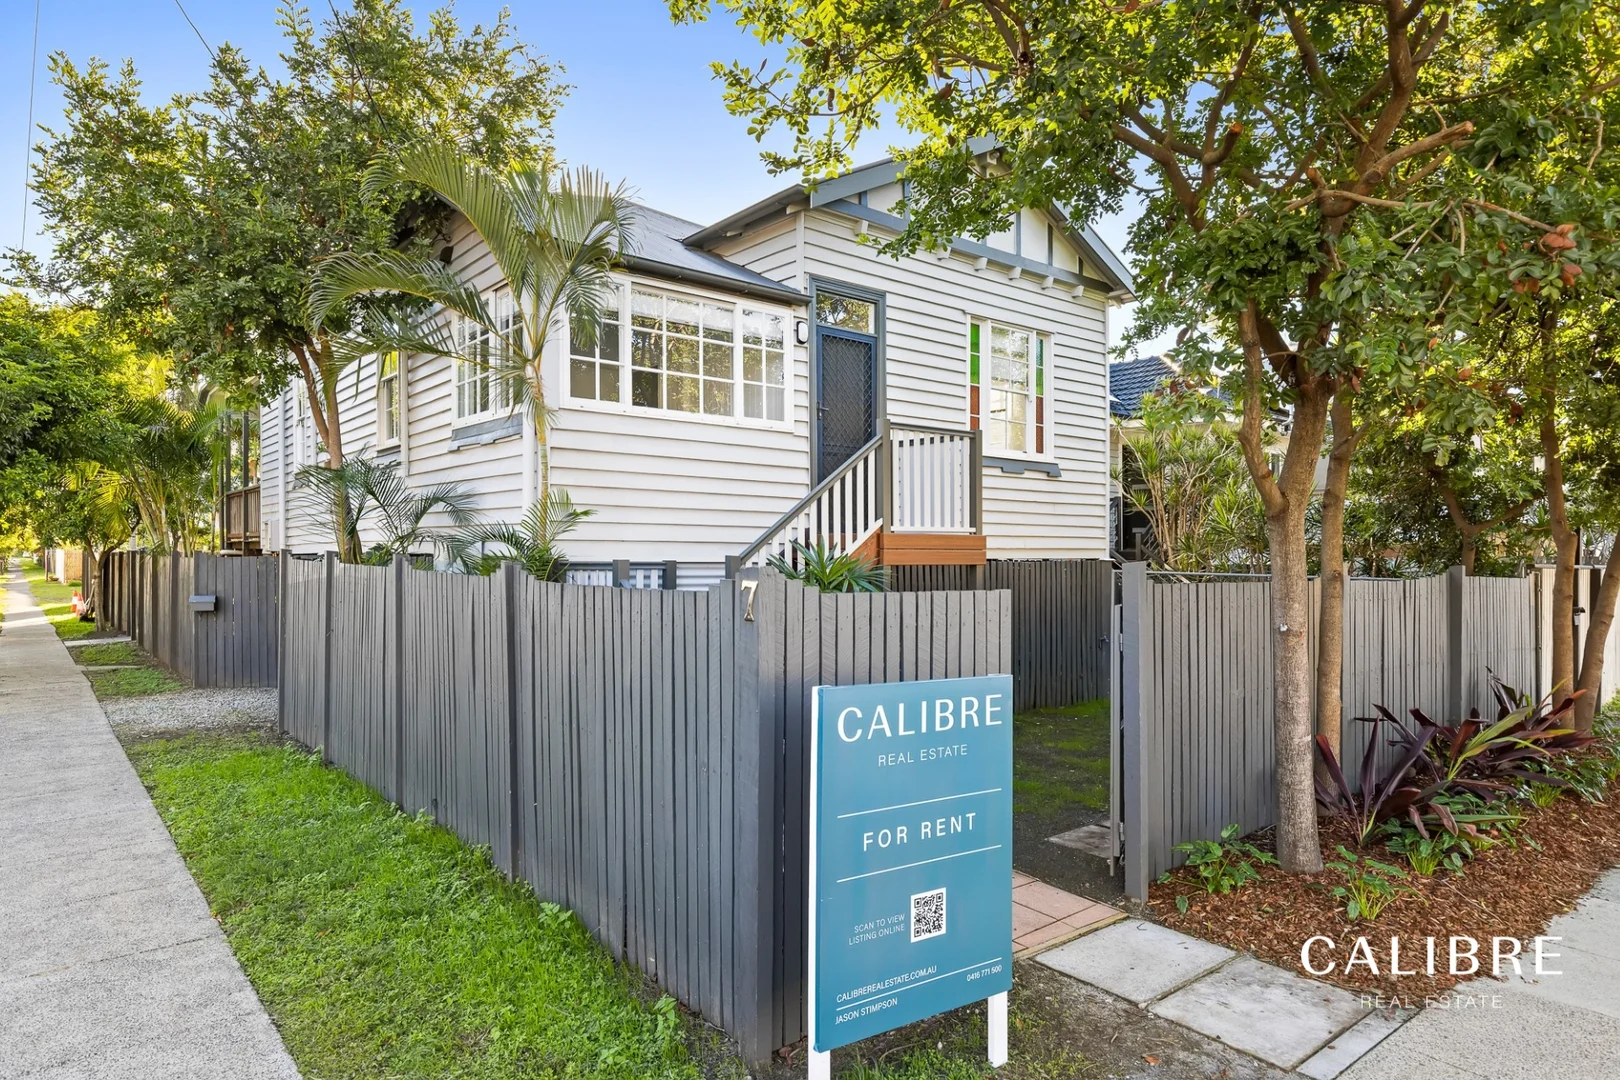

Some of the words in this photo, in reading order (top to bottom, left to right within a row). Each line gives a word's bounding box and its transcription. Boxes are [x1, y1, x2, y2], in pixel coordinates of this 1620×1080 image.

[741, 580, 758, 621] 7
[837, 694, 1002, 742] CALIBRE
[878, 752, 914, 767] REAL
[920, 744, 968, 761] ESTATE
[863, 826, 908, 851] FOR
[921, 813, 976, 839] RENT
[848, 931, 877, 945] LISTING
[878, 924, 905, 937] ONLINE
[854, 922, 874, 934] SCAN
[876, 918, 886, 929] TO
[887, 913, 905, 926] VIEW
[836, 965, 937, 1003] CALIBREREALESTATE.COM.AU
[966, 970, 980, 982] 0416
[981, 968, 990, 978] 771
[991, 965, 1003, 975] 500
[835, 1010, 859, 1025] JASON
[860, 997, 898, 1017] STIMPSON
